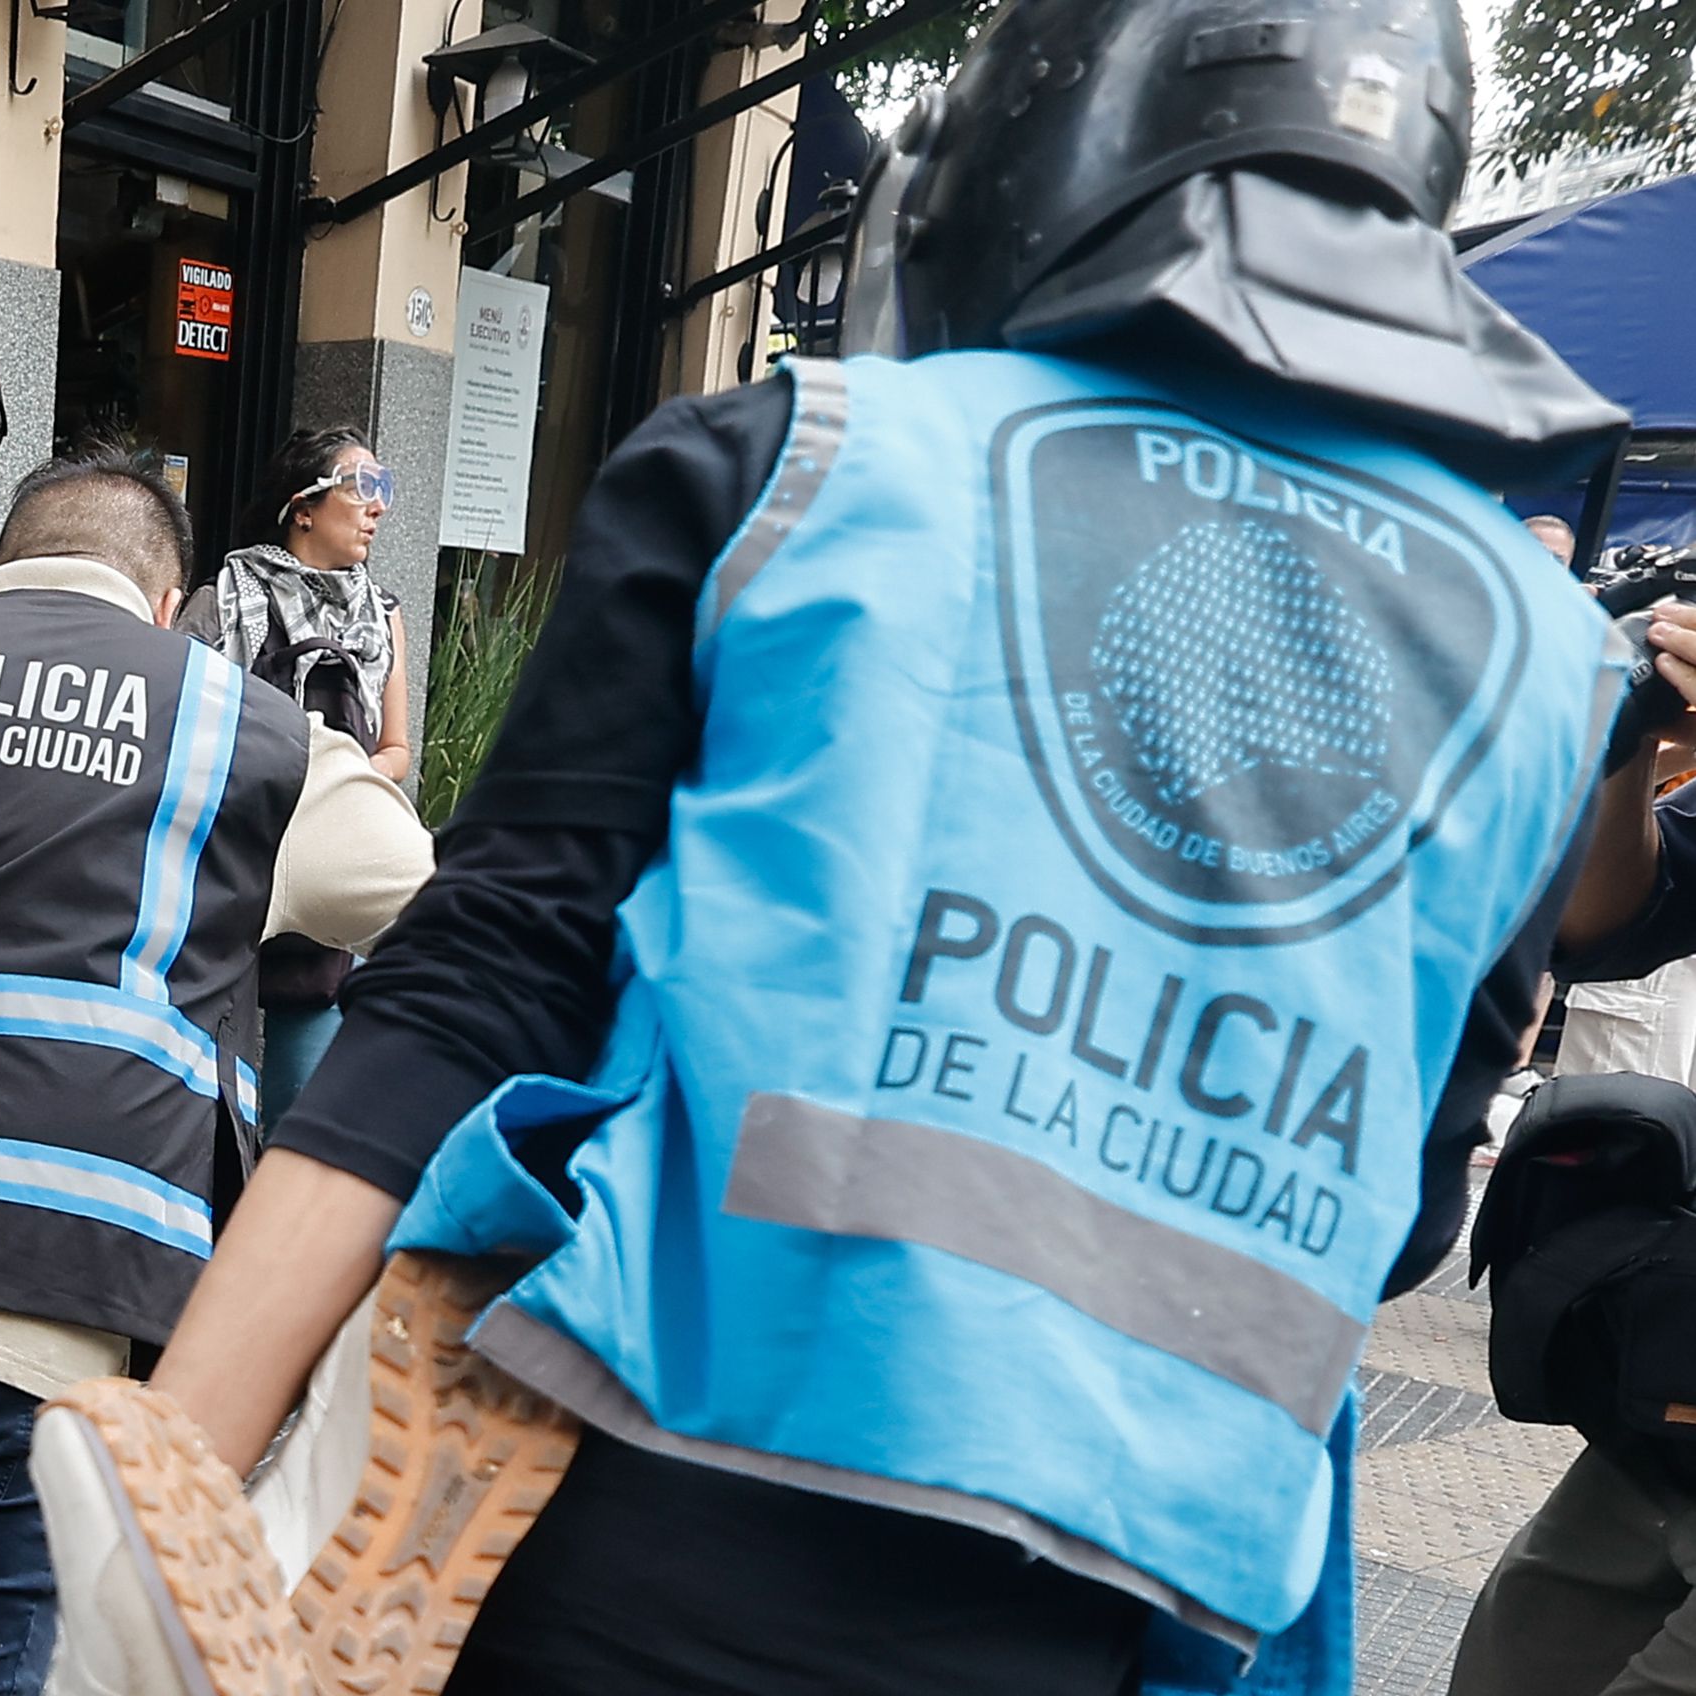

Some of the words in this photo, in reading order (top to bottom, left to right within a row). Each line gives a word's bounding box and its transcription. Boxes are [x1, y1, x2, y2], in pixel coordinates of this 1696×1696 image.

[182, 264, 232, 291] VIGILADO
[470, 323, 511, 344] EJECUTIVO
[480, 306, 503, 324] MENÚ
[177, 320, 229, 352] DETECT
[1135, 431, 1407, 575] POLICIA
[1063, 691, 1093, 725] DE
[0, 725, 143, 787] CIUDAD
[1071, 731, 1105, 768] LA
[1092, 769, 1180, 850] CIUDAD
[1331, 789, 1399, 855] AIRES
[1180, 832, 1224, 868] DE
[1226, 838, 1332, 878] BUENOS
[899, 888, 1369, 1177] POLICIA
[875, 1026, 989, 1102] DE
[1004, 1052, 1078, 1148] LA
[1099, 1103, 1343, 1257] CIUDAD
